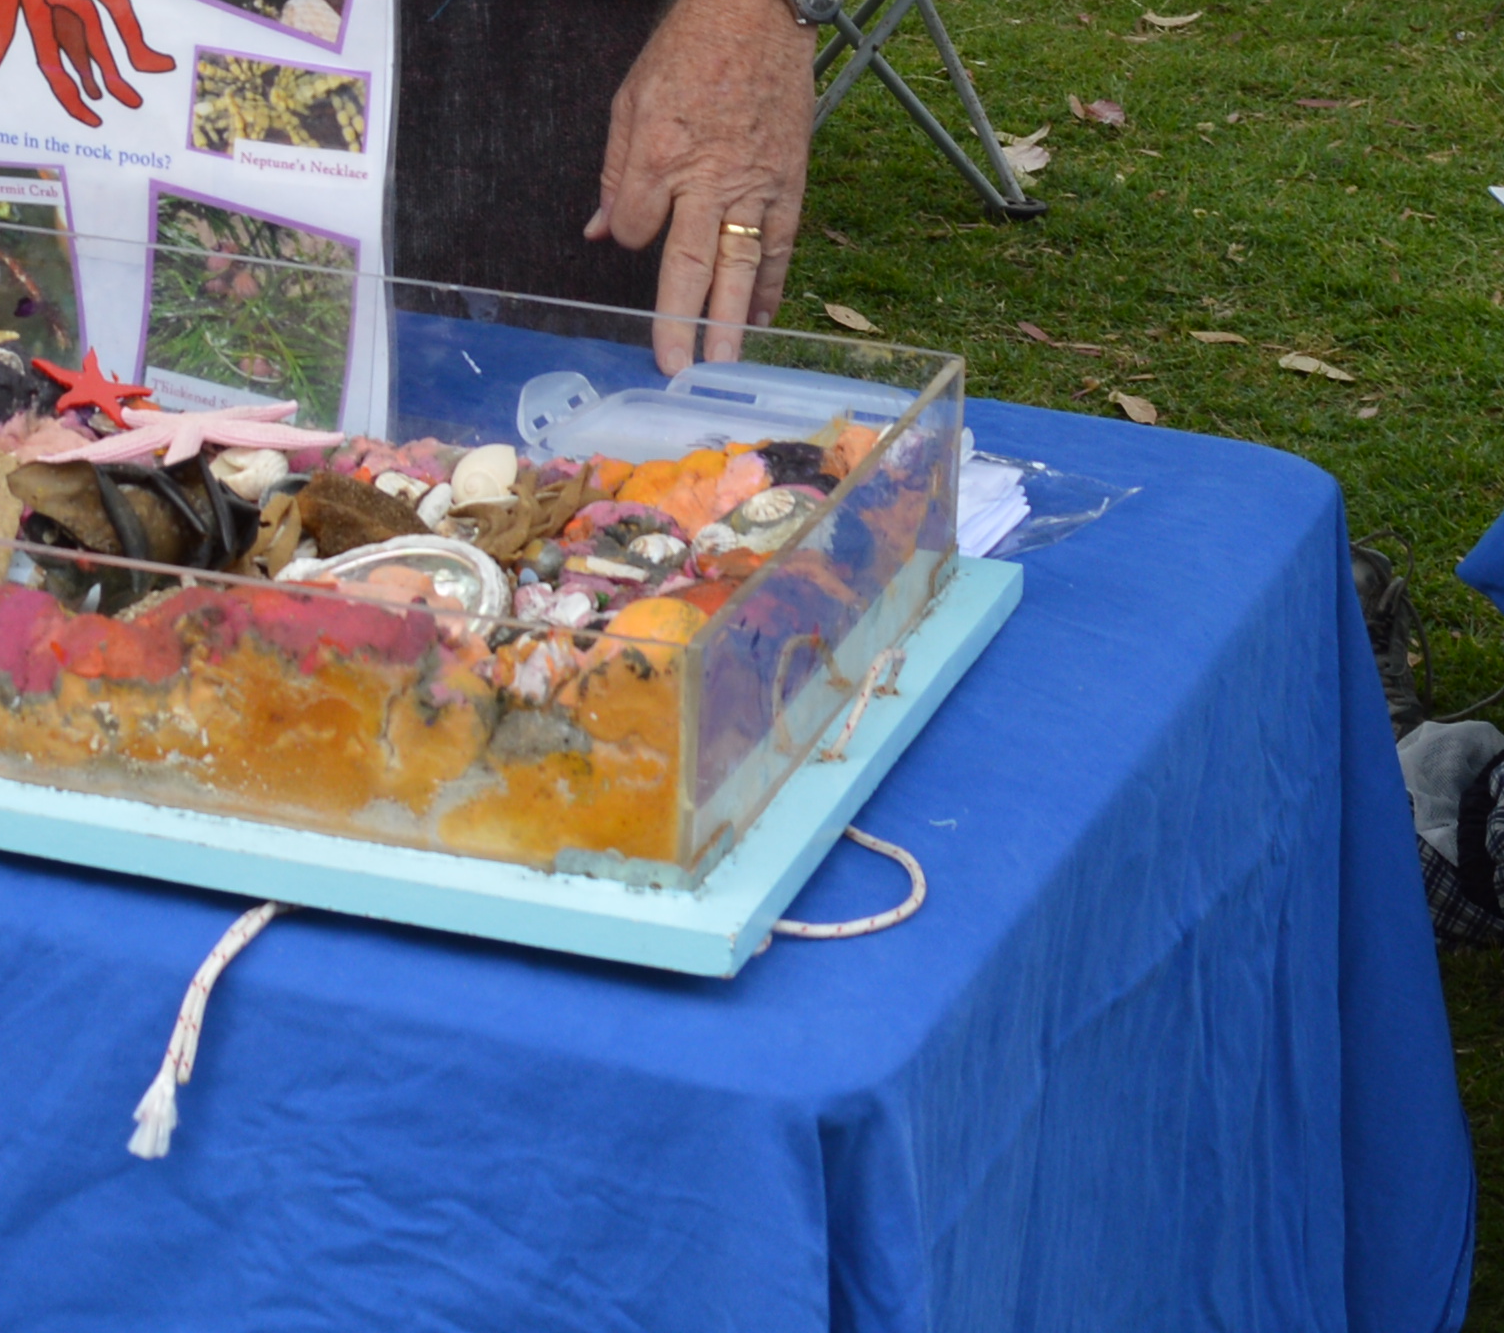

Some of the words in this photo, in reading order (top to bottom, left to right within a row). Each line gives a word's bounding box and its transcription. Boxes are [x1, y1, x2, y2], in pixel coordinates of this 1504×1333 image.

[24, 131, 40, 149] in
[44, 136, 70, 155] the
[75, 142, 112, 162] rock
[118, 149, 172, 171] pools?
[240, 151, 306, 172] Neptune's
[310, 160, 369, 180] Necklace
[28, 183, 59, 199] Crab
[151, 377, 217, 408] Thickened
